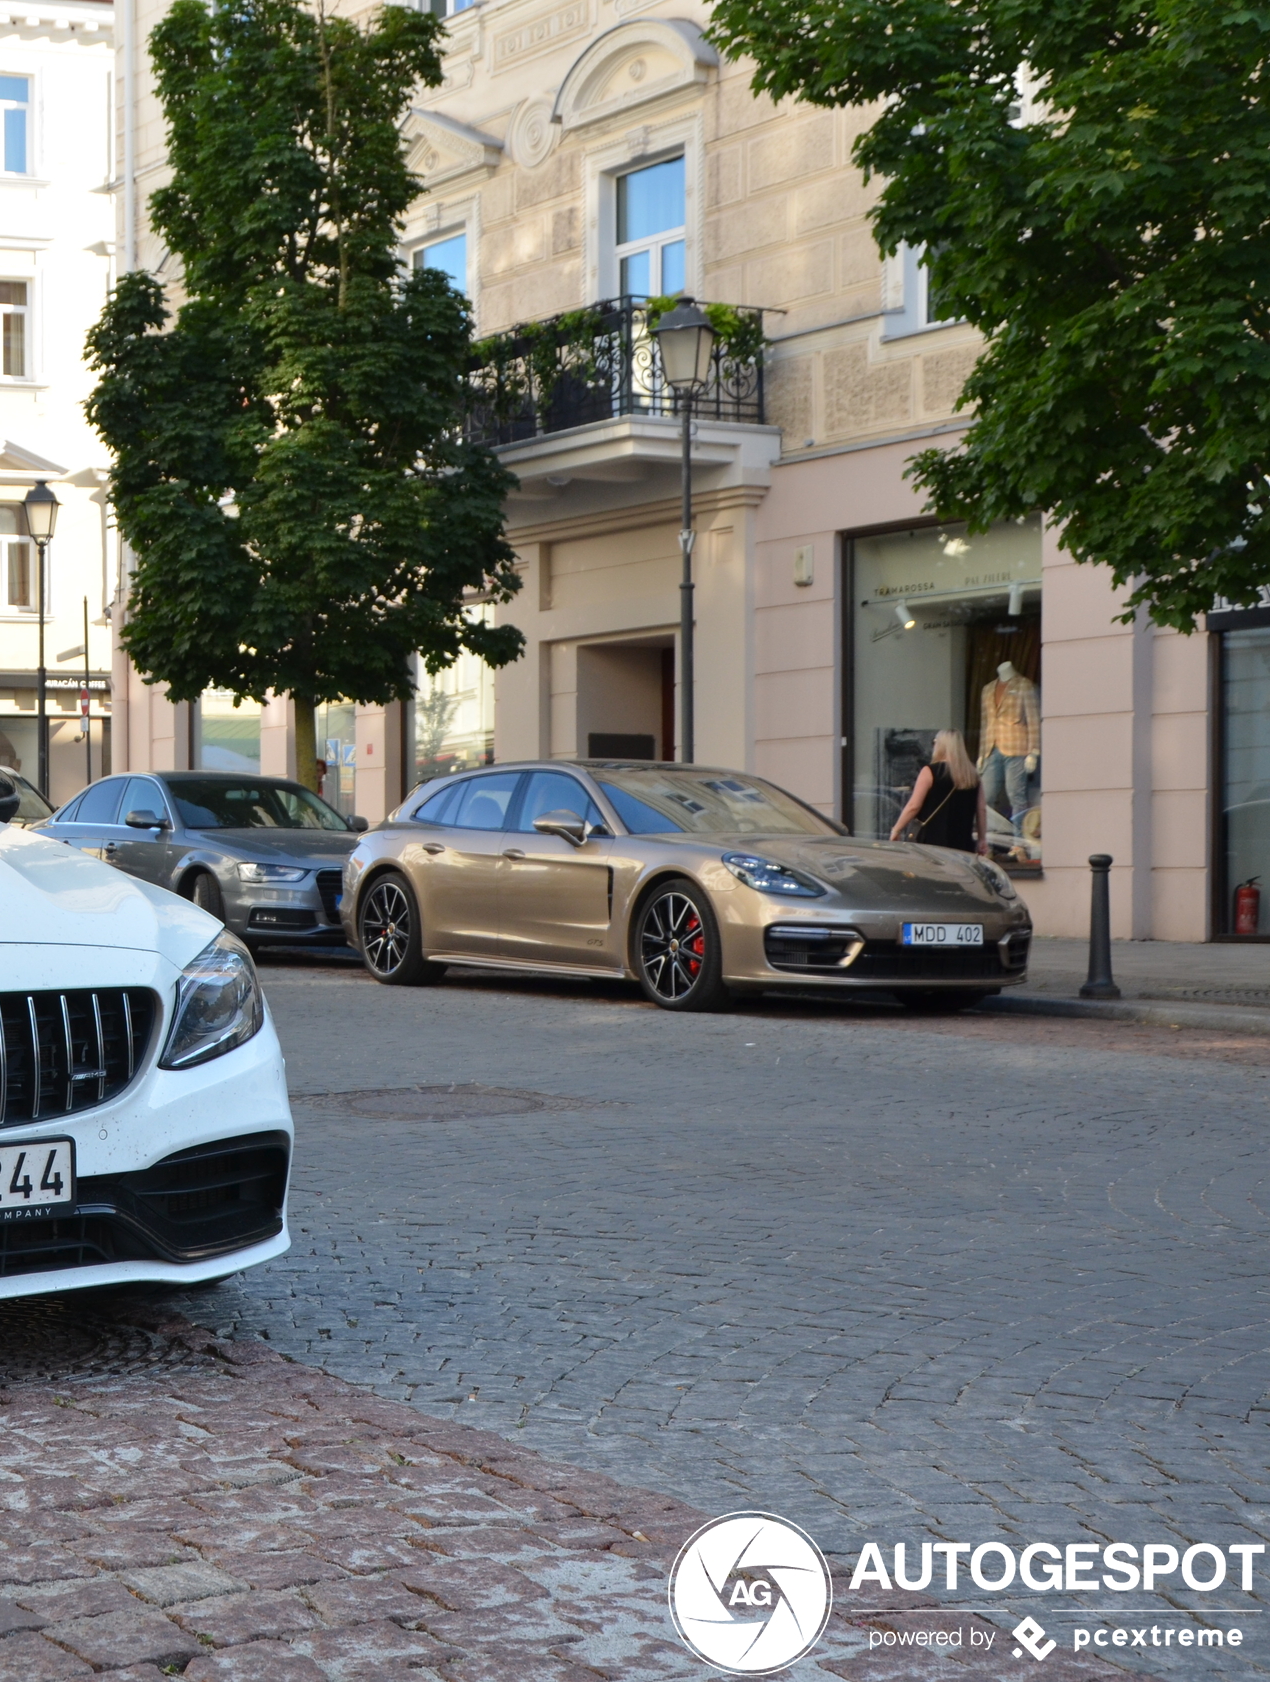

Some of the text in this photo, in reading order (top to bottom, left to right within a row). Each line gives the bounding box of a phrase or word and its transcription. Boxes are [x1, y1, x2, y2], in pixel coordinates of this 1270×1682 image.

[874, 582, 935, 596] TRAMAROSSA
[914, 926, 946, 942] MDD
[957, 926, 981, 942] 402
[587, 939, 603, 947] GTS
